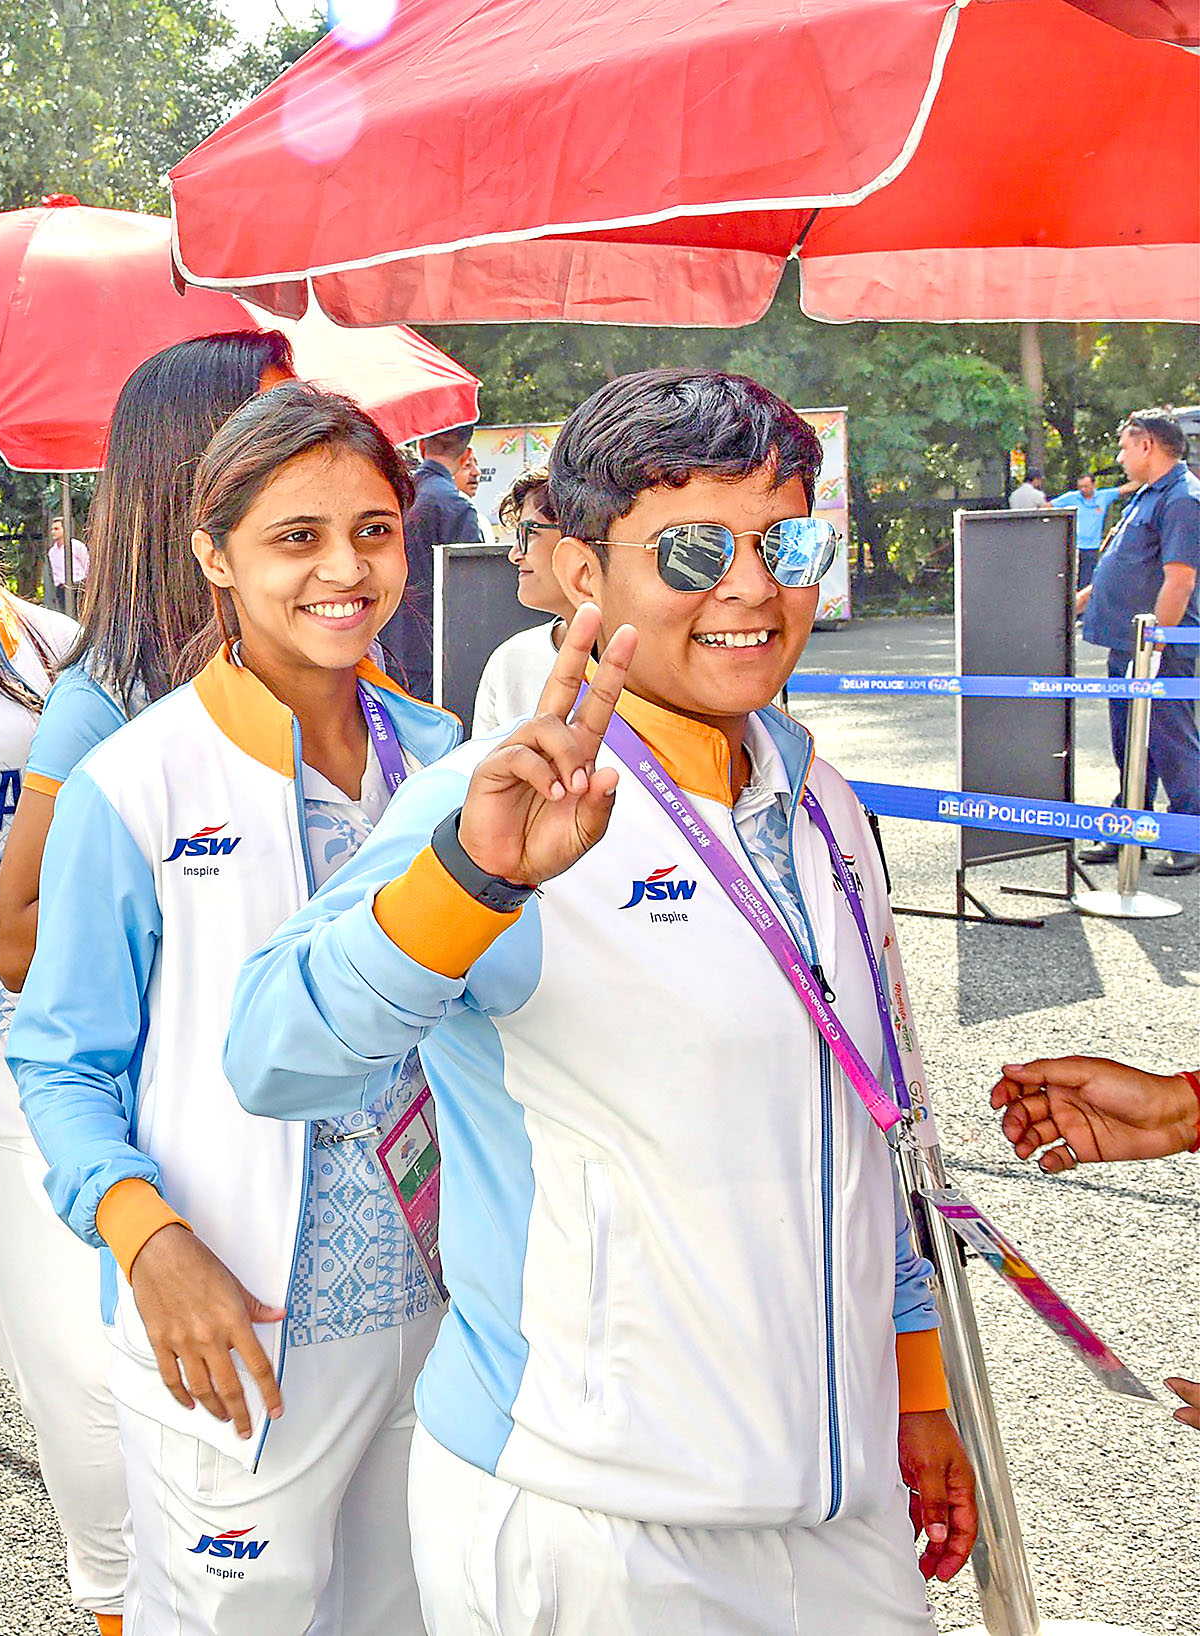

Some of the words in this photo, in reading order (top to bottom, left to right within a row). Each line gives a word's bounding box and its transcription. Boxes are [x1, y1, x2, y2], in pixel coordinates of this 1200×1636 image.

[843, 680, 870, 689] DELHI
[1032, 682, 1062, 692] DELHI
[638, 759, 712, 848] 杭州第19届亚运会
[938, 799, 985, 819] DELHI
[988, 807, 1050, 826] POLICE
[161, 837, 242, 863] JSW
[183, 866, 220, 877] Inspire
[617, 880, 697, 910] JSW
[735, 877, 774, 929] Hangzhou
[649, 911, 688, 924] Inspire
[790, 963, 811, 990] Cloud
[807, 988, 831, 1023] Alibaba
[413, 1165, 422, 1177] F
[186, 1534, 270, 1560] JSW
[206, 1564, 245, 1579] Inspire
